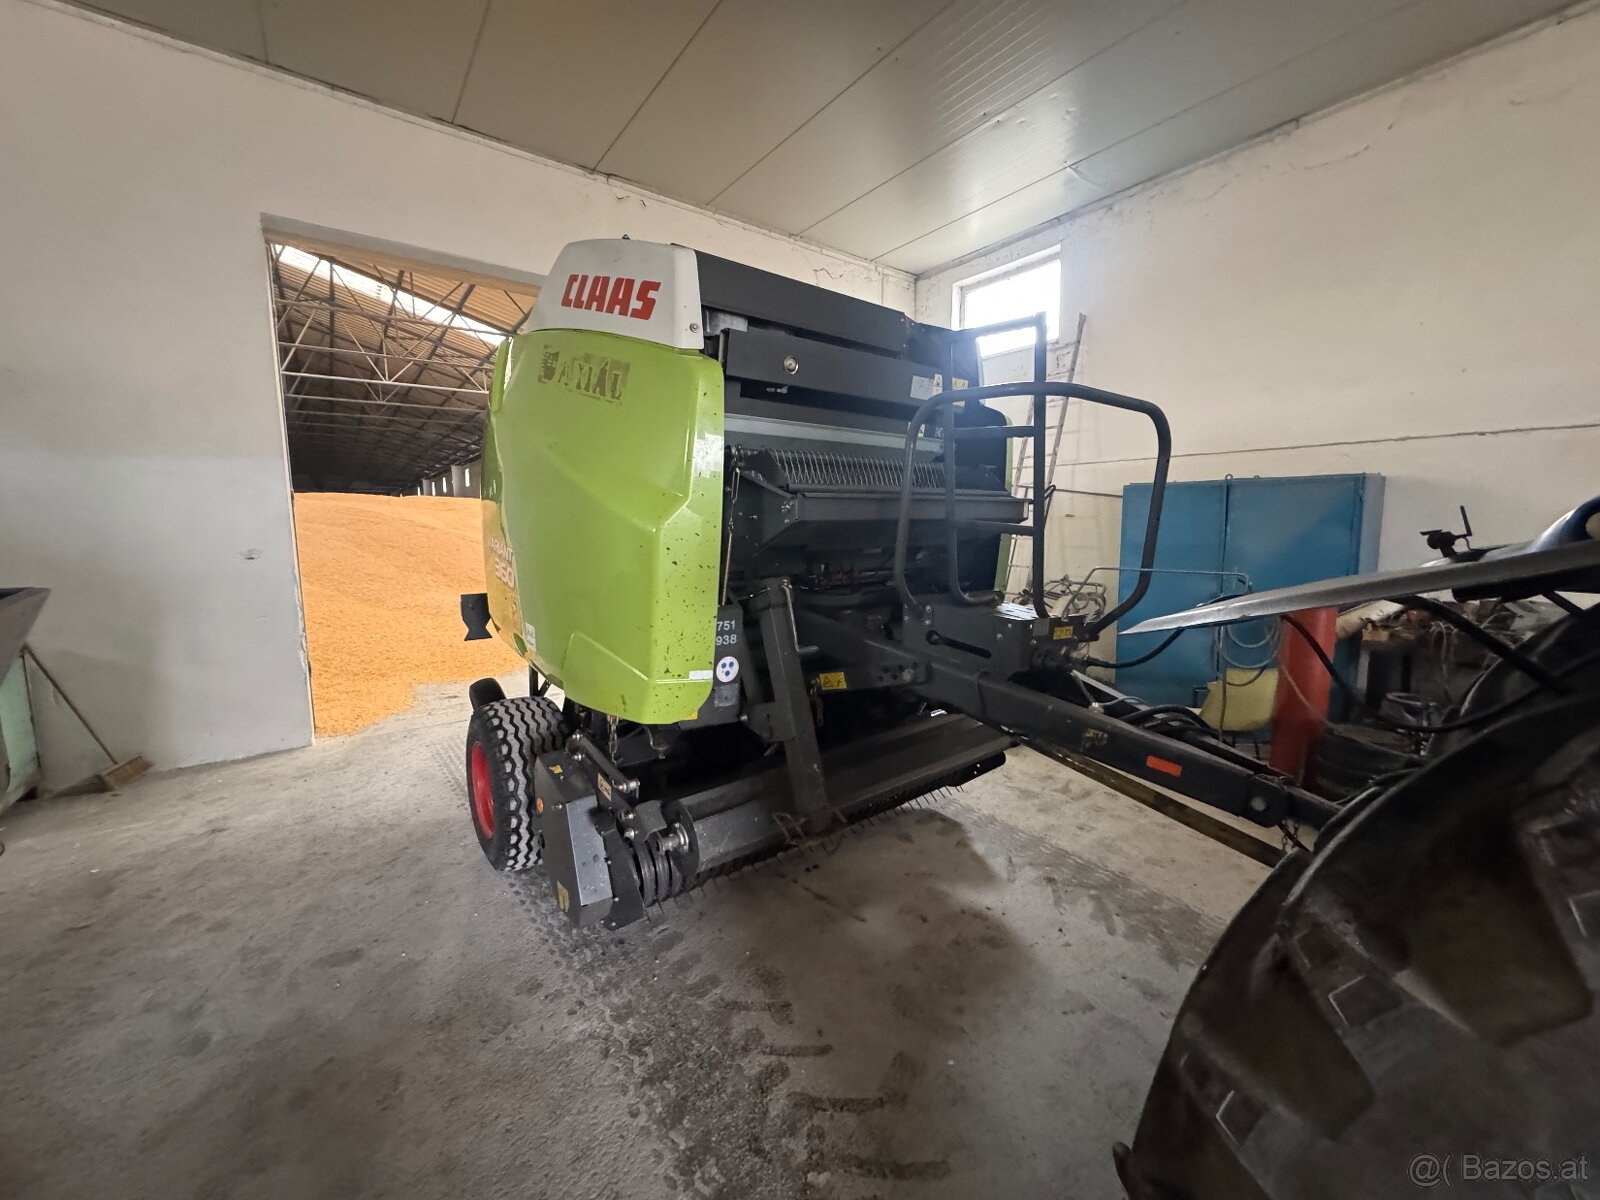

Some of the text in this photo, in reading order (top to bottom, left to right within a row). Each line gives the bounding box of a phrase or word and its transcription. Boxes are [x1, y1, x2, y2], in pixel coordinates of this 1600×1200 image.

[561, 274, 661, 320] CLAAS
[716, 620, 736, 631] 751
[716, 634, 737, 646] 938
